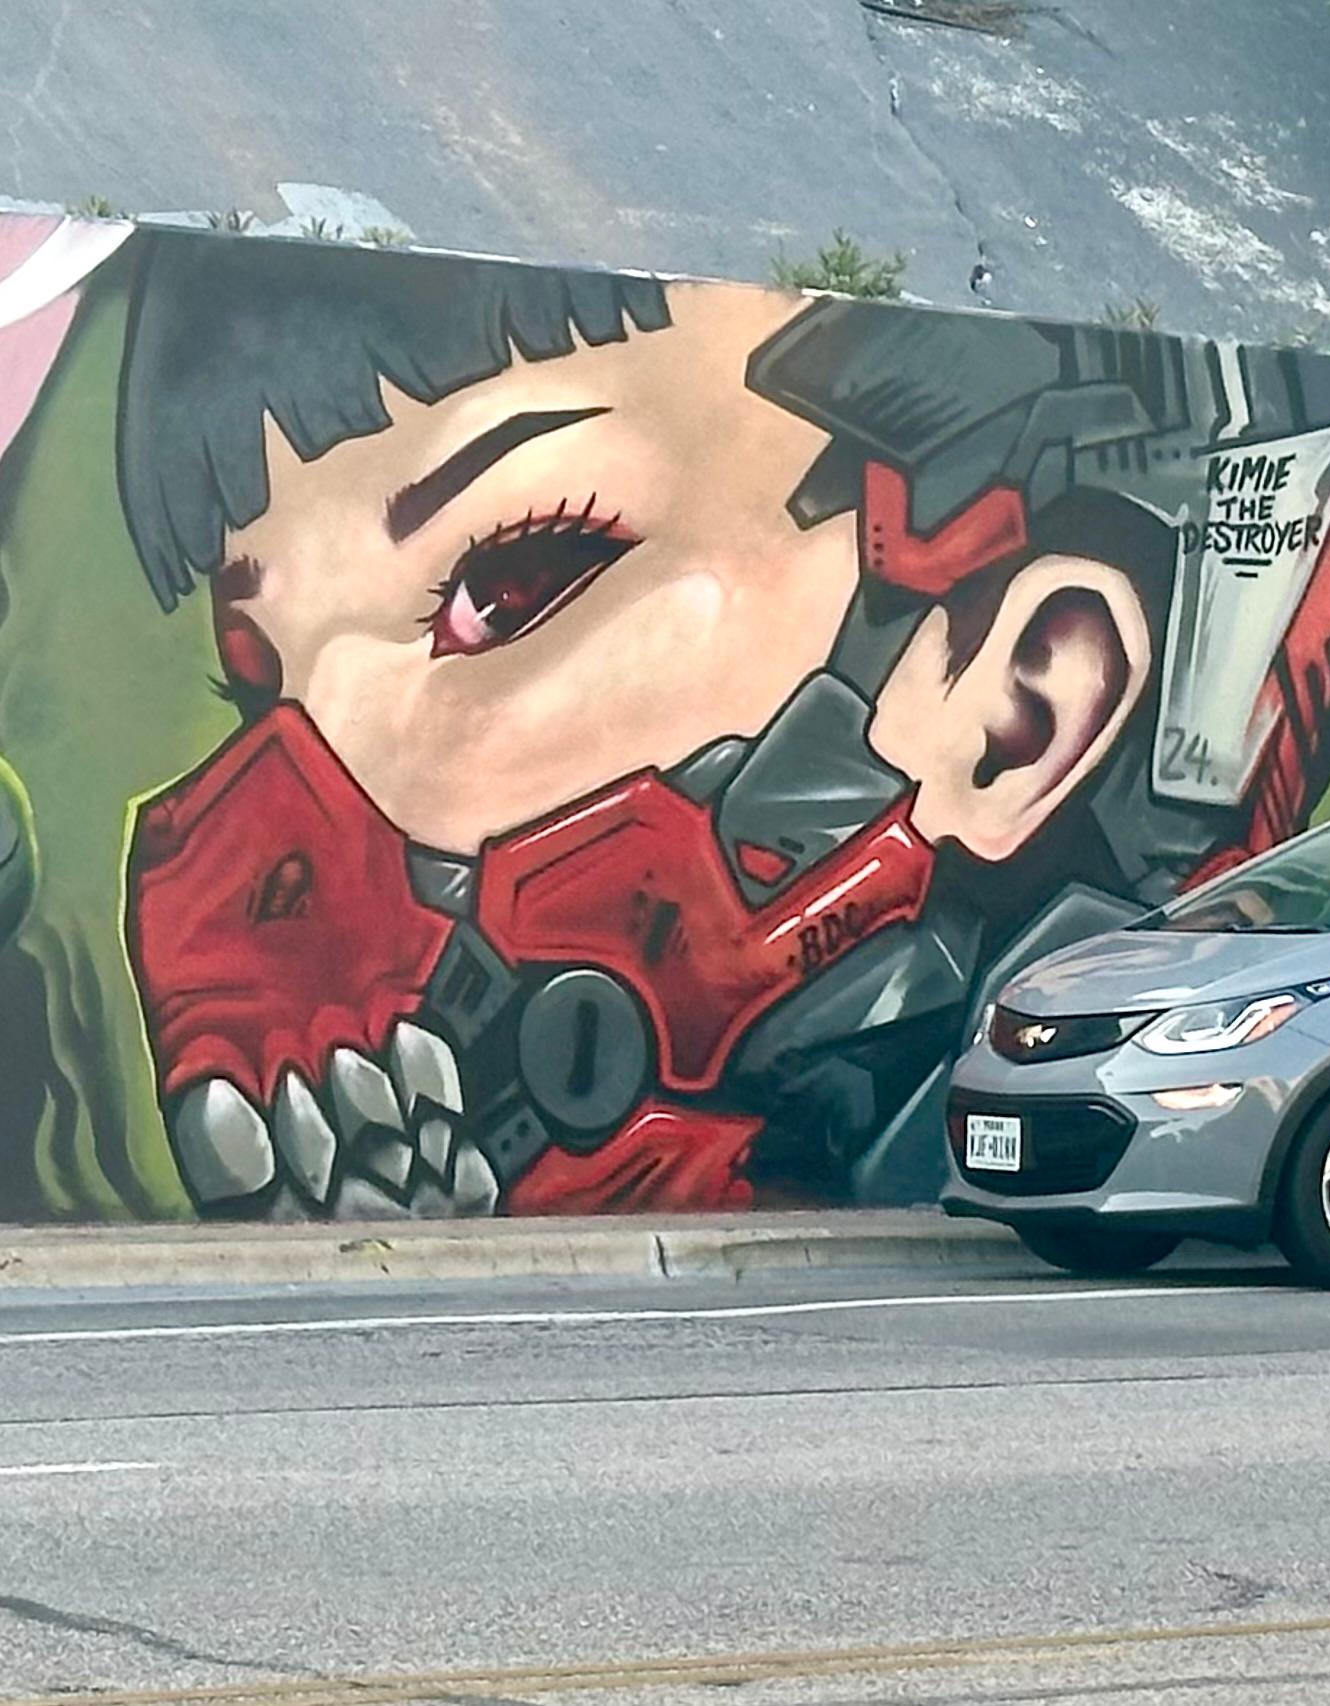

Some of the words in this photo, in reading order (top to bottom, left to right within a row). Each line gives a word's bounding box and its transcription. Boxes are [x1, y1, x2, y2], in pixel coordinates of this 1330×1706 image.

[1207, 453, 1296, 495] KIMIE
[1216, 496, 1276, 521] THE
[1182, 515, 1322, 556] DESTROYER
